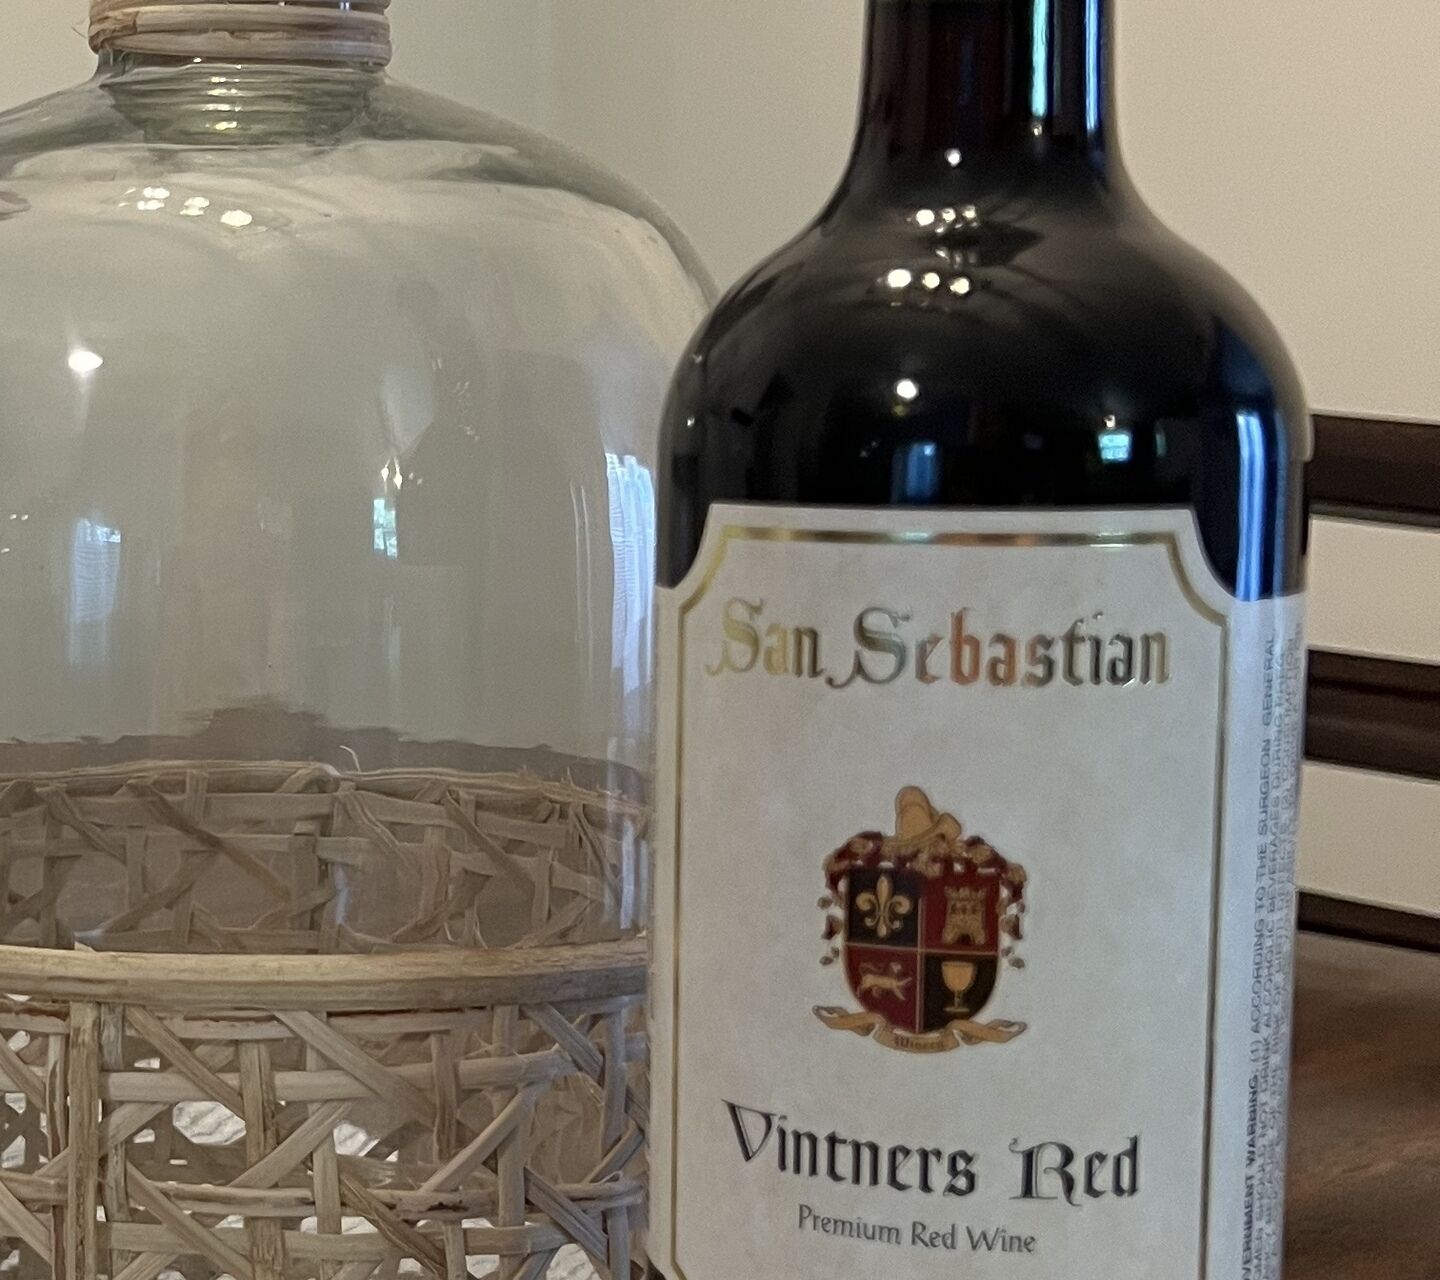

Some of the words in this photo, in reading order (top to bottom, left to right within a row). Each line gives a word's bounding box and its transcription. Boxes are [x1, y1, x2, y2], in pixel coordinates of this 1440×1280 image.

[704, 597, 824, 678] San
[825, 606, 1171, 689] Sebastian
[1257, 738, 1271, 836] SURGEON
[1255, 842, 1267, 883] THE
[1254, 886, 1266, 914] TO
[1250, 918, 1264, 1034] ACCORDING
[1249, 1039, 1262, 1063] (1)
[721, 1099, 979, 1197] Vintners
[1008, 1134, 1139, 1207] Red
[798, 1203, 902, 1246] Premium
[911, 1220, 956, 1251] Red
[966, 1224, 1037, 1254] Wine
